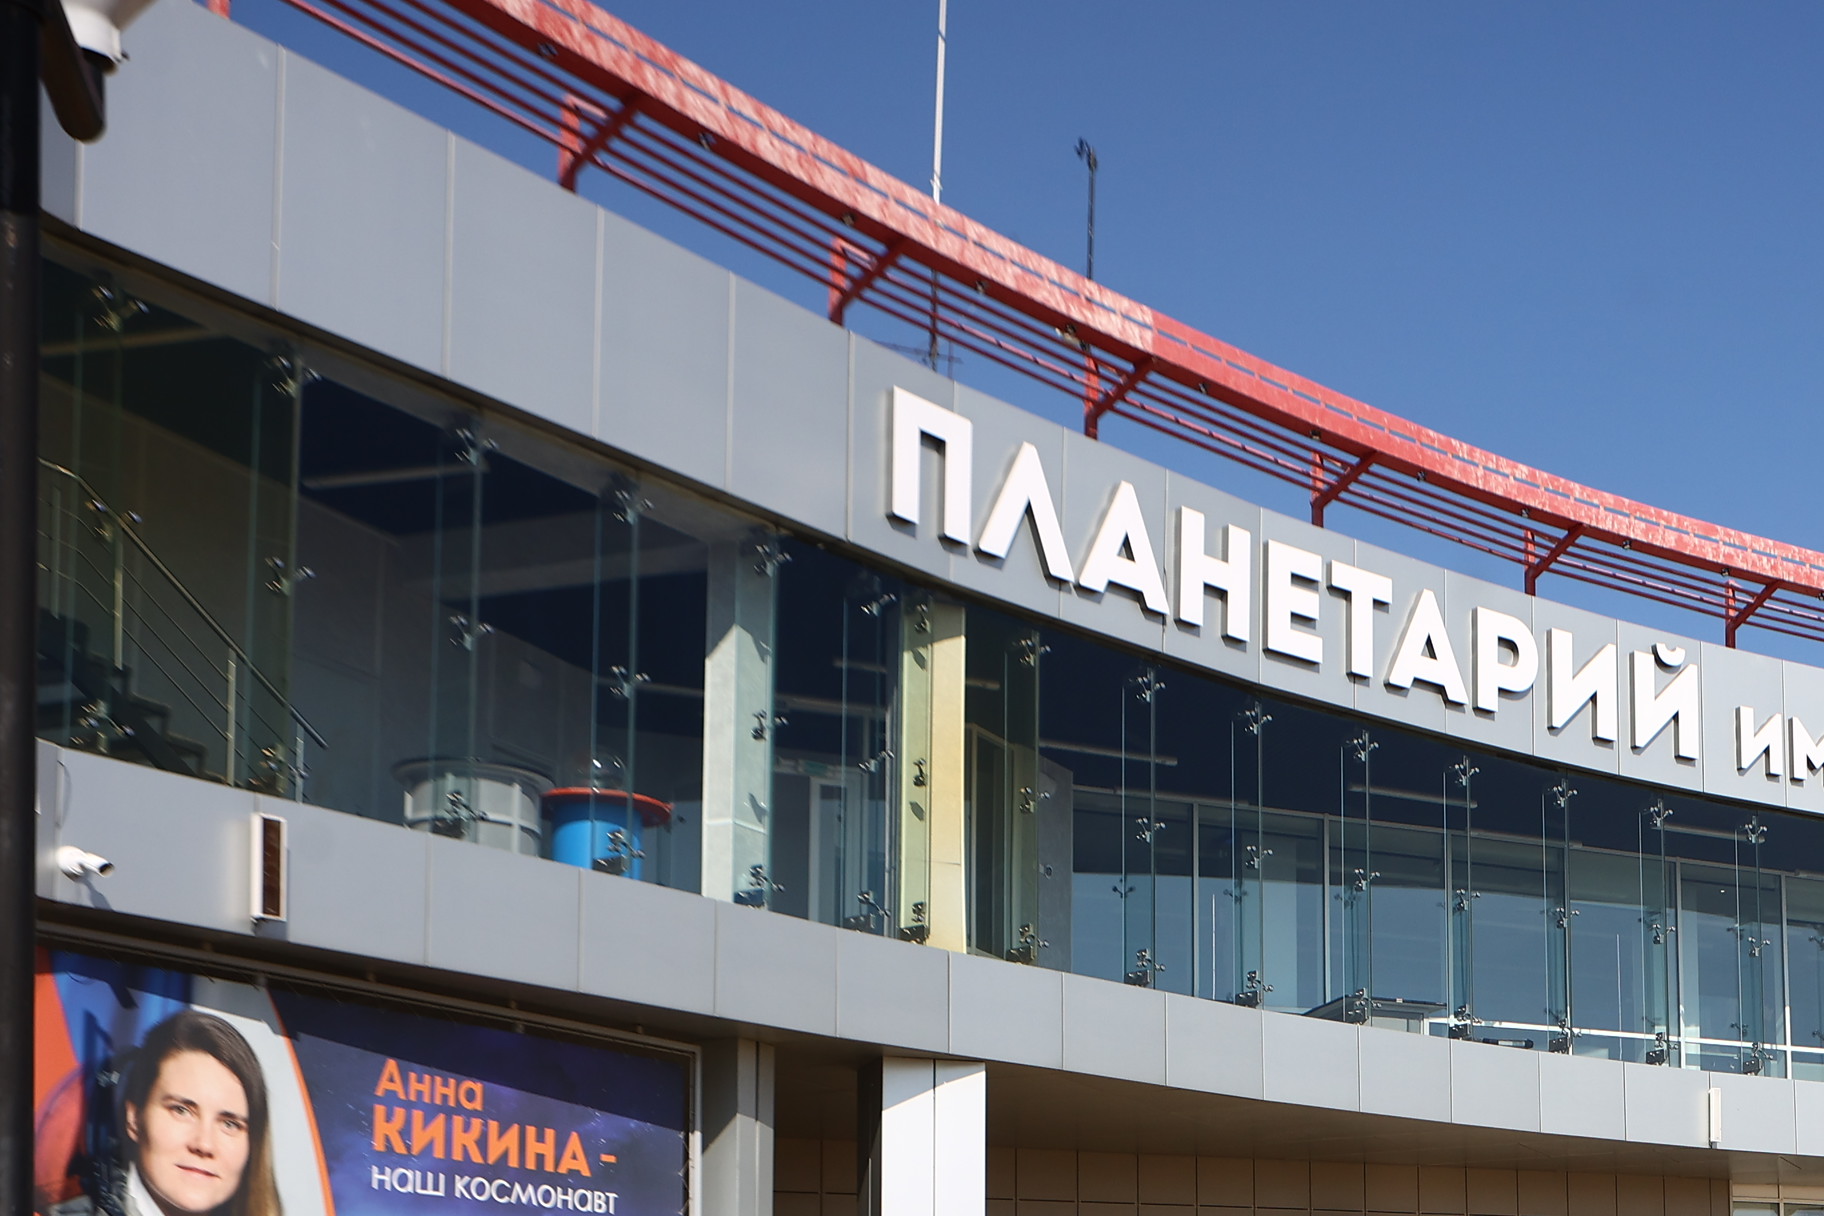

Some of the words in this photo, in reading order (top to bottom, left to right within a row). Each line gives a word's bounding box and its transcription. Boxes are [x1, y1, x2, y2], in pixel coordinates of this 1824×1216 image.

[891, 384, 1699, 761] ПЛАНЕТАРИЙ
[374, 1058, 485, 1111] Анна
[372, 1103, 592, 1177] КИКИНА
[371, 1165, 446, 1197] наш
[454, 1173, 618, 1215] космонавт
